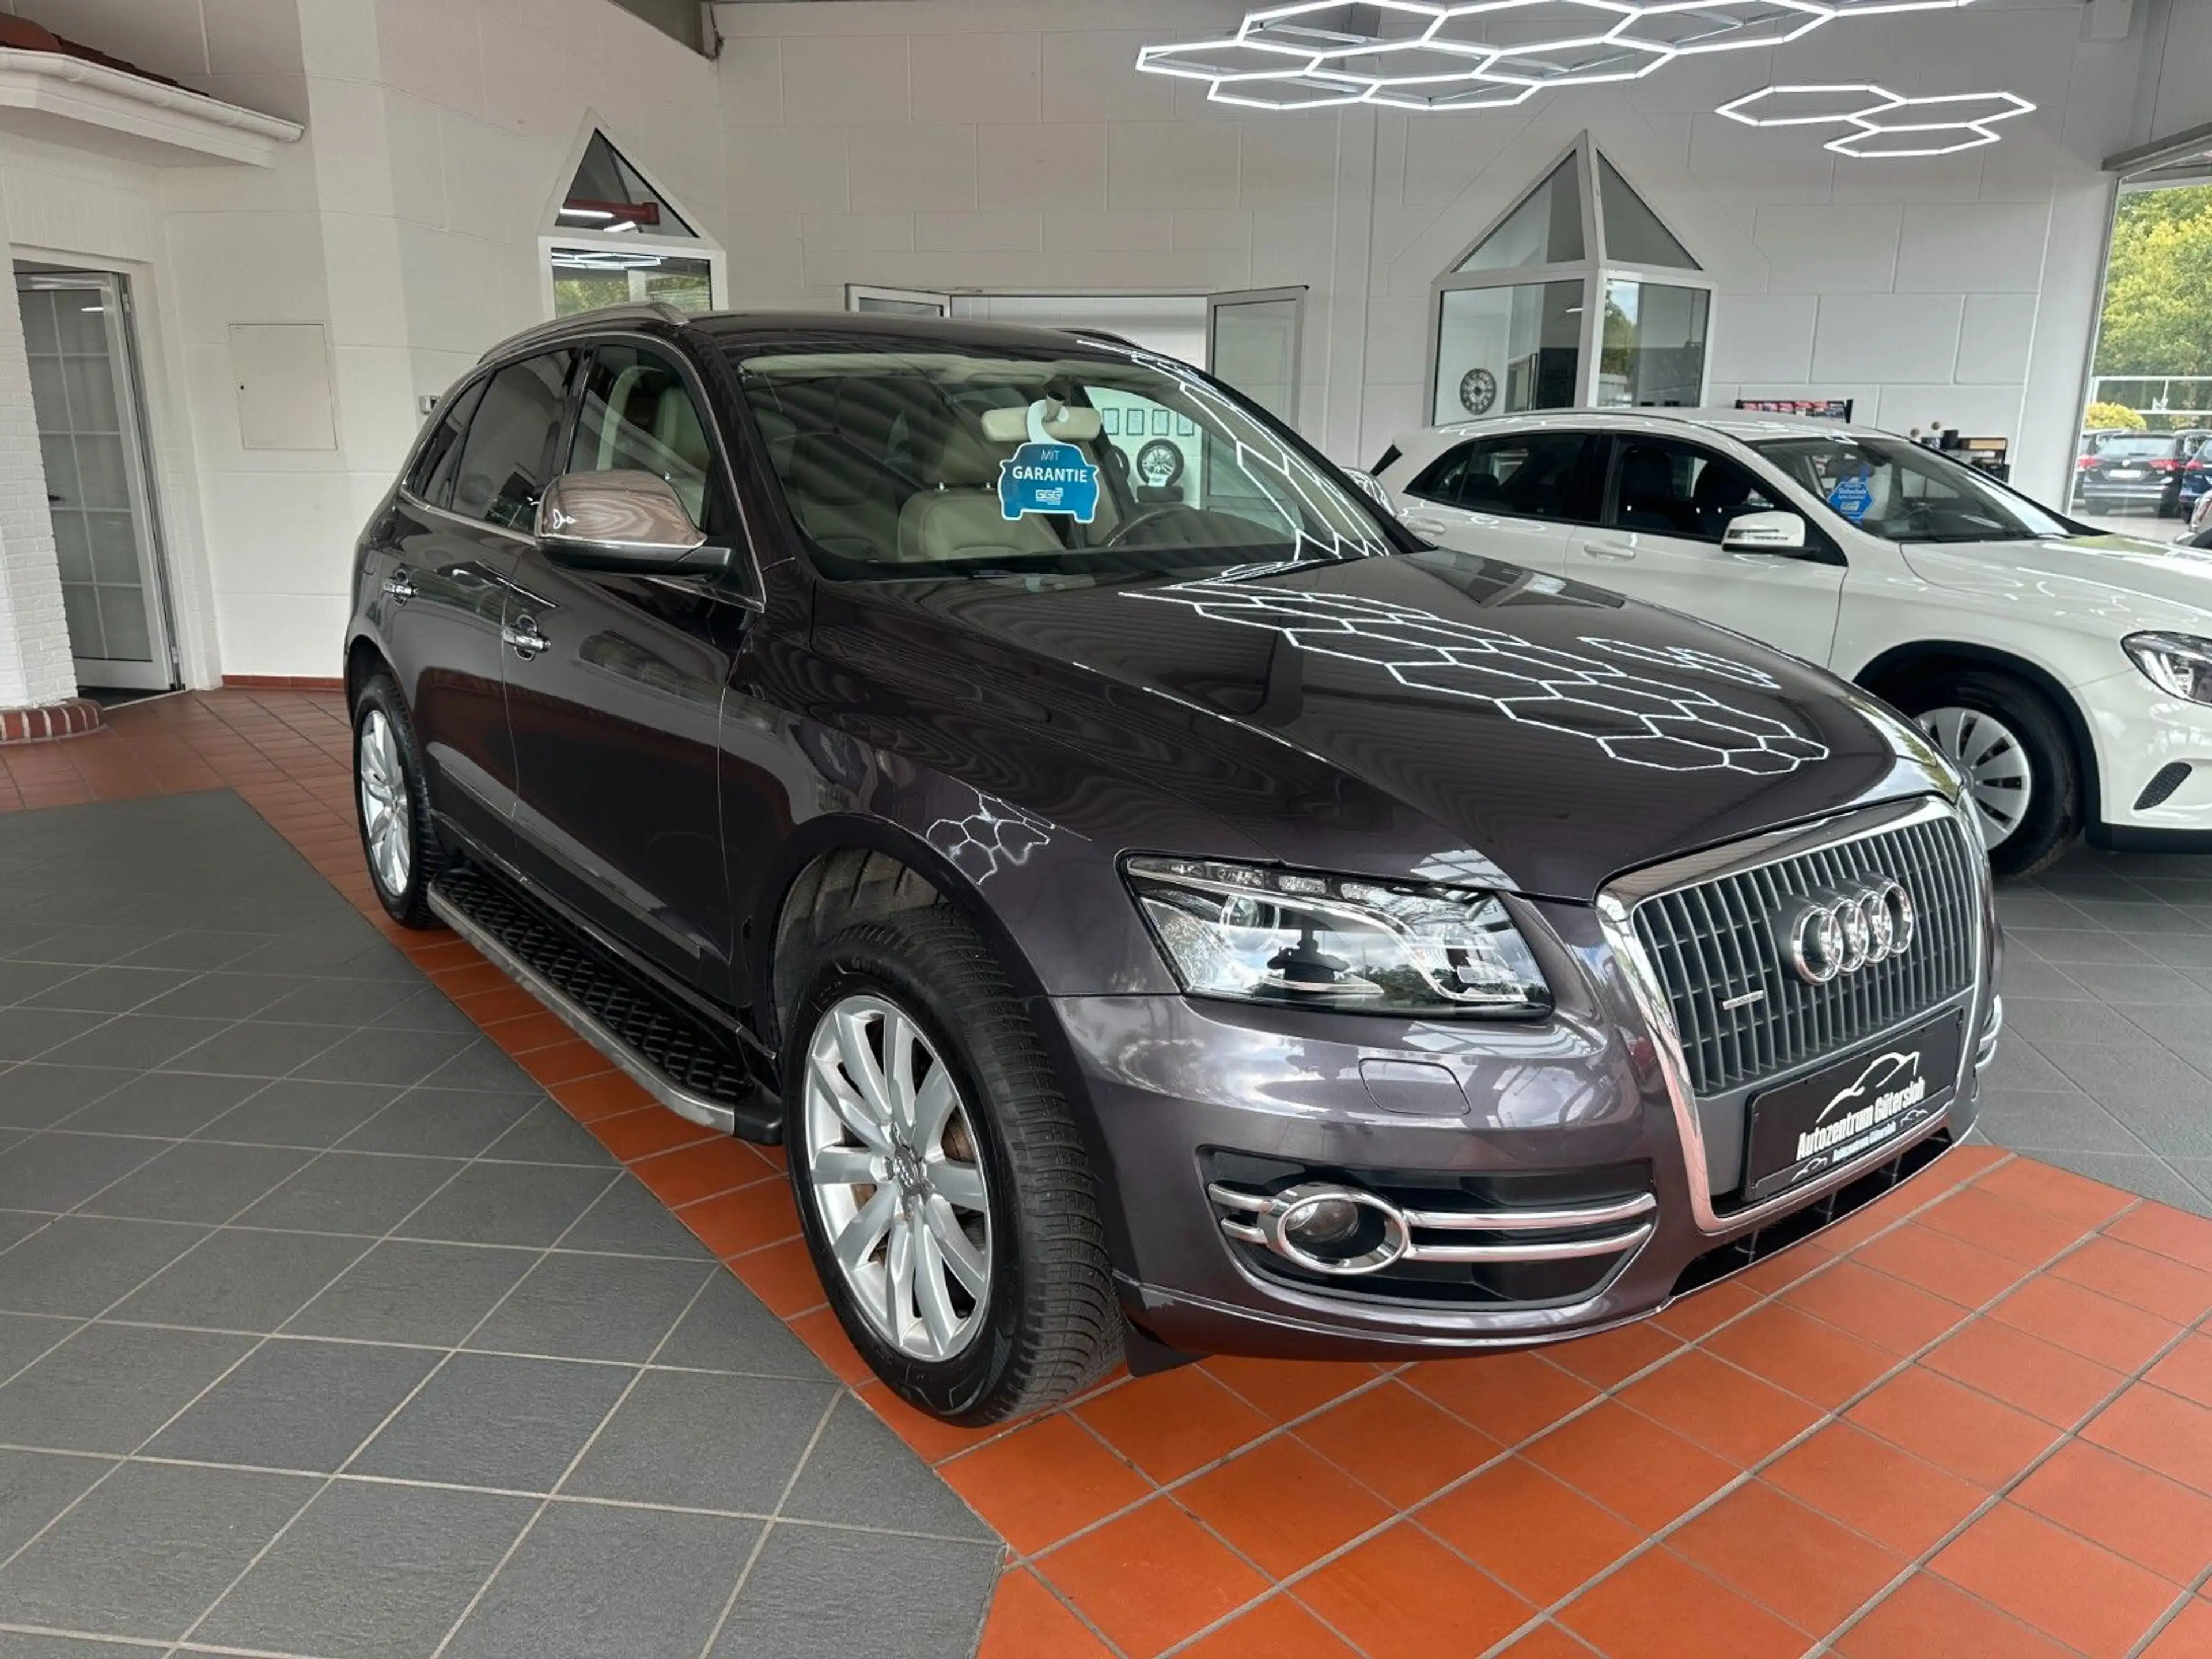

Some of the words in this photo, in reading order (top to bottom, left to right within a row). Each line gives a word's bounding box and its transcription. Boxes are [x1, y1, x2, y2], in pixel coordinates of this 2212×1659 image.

[1041, 449, 1060, 461] MIT
[1013, 465, 1088, 482] GARANTIE
[1796, 1104, 1874, 1161] Autozentrum
